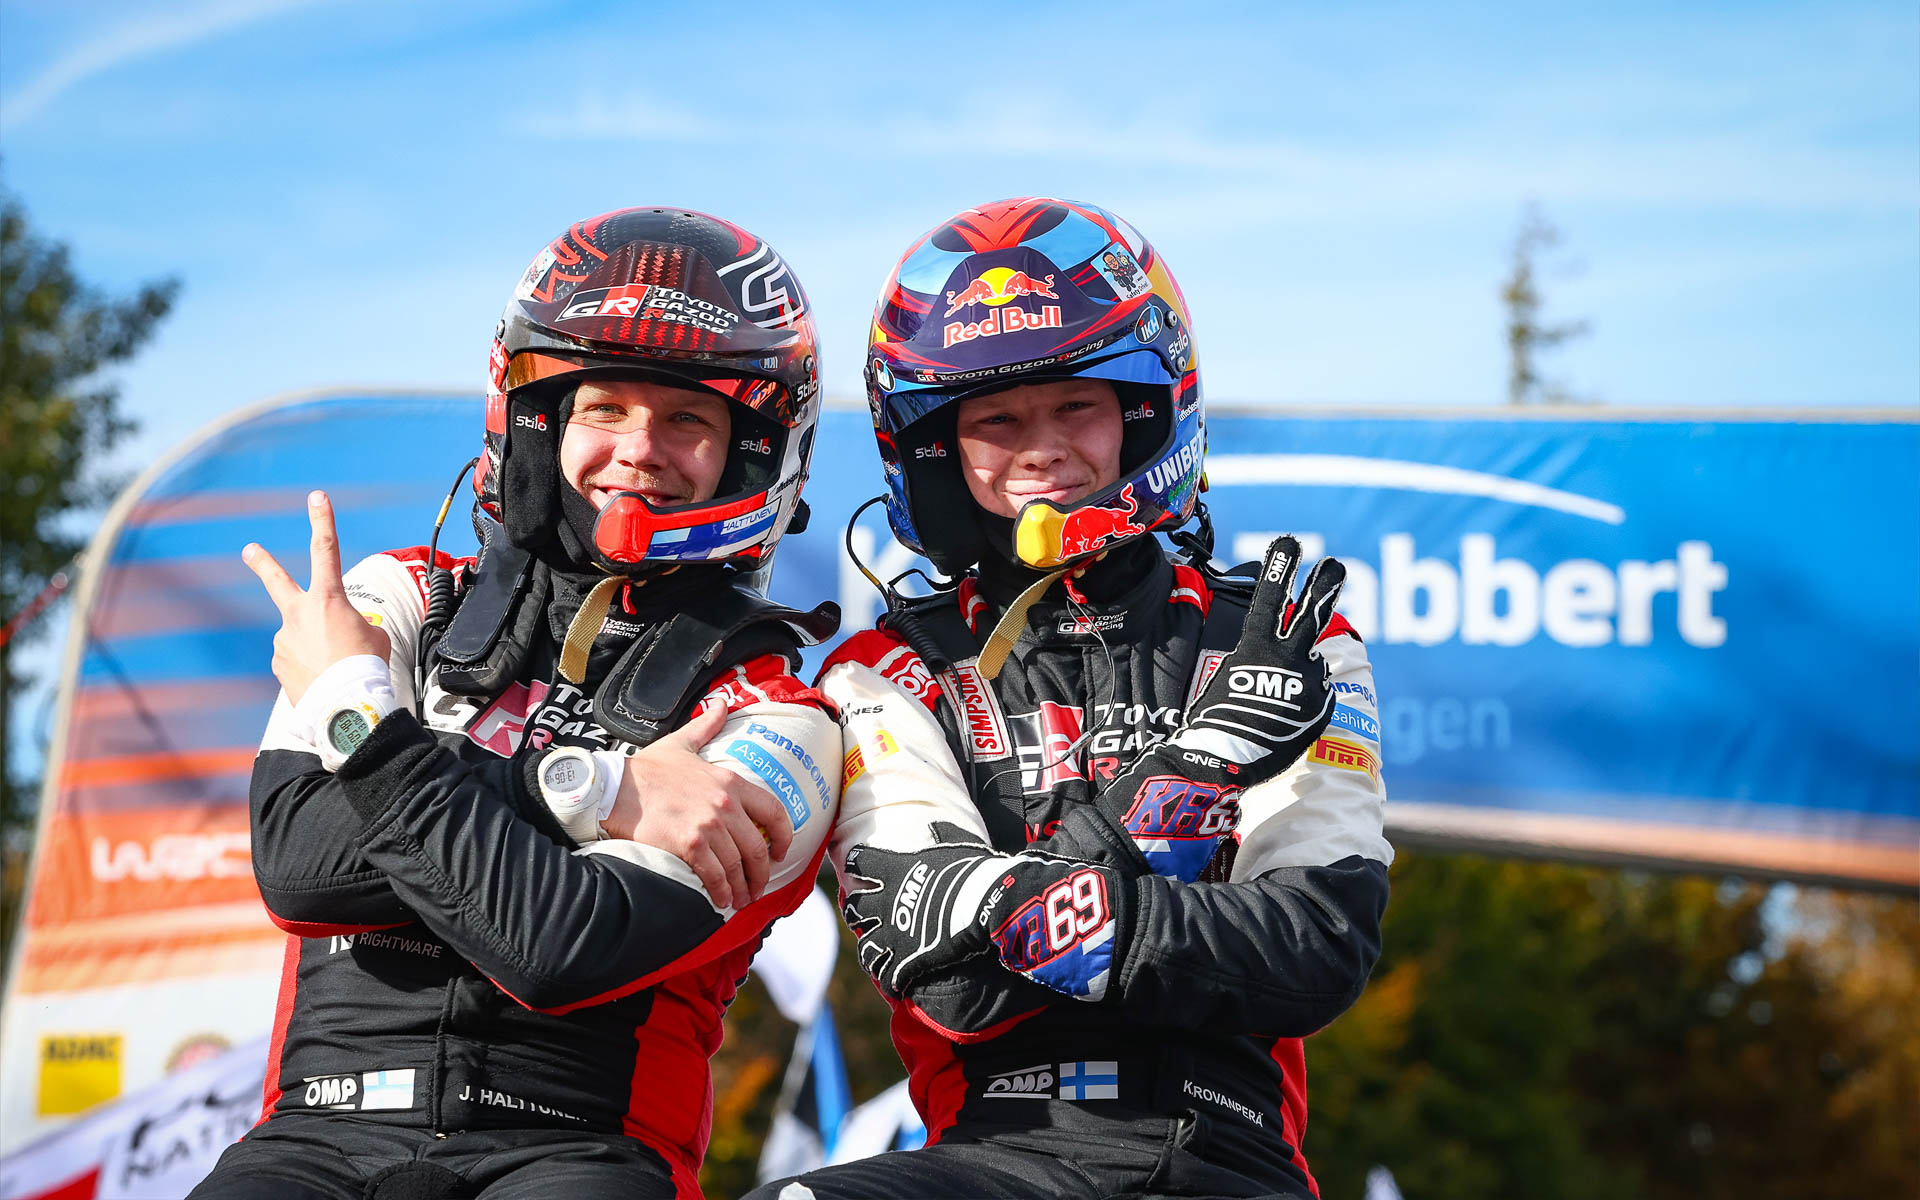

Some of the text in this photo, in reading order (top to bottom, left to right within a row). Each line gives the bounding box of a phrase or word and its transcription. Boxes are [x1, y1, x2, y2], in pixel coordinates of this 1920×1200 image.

[559, 293, 643, 319] GR
[643, 307, 726, 334] Racing
[648, 298, 731, 328] GAZOO
[652, 286, 739, 324] TOYOTA
[943, 305, 1063, 348] Red Bull
[916, 338, 1104, 383] GR TOYOTA GAZOO Racing
[722, 507, 773, 531] HALTTUNEN
[1266, 551, 1289, 583] OMP
[1059, 622, 1092, 633] GR
[1228, 670, 1303, 701] OMP
[534, 705, 611, 745] GAZ
[1094, 703, 1181, 729] TOYO
[1331, 709, 1380, 736] sahiKA
[1090, 729, 1168, 754] GAZ
[746, 722, 831, 810] Panasonic
[1182, 751, 1240, 775] ONE-S
[1315, 740, 1379, 780] PIREL
[735, 743, 807, 821] AsahiKASEI
[895, 863, 929, 932] OMP
[978, 874, 1016, 927] ONE-S
[359, 932, 443, 959] RIGHTWARE
[304, 1076, 358, 1107] OMP
[986, 1070, 1054, 1094] OMP
[458, 1085, 588, 1122] J. HALTTU
